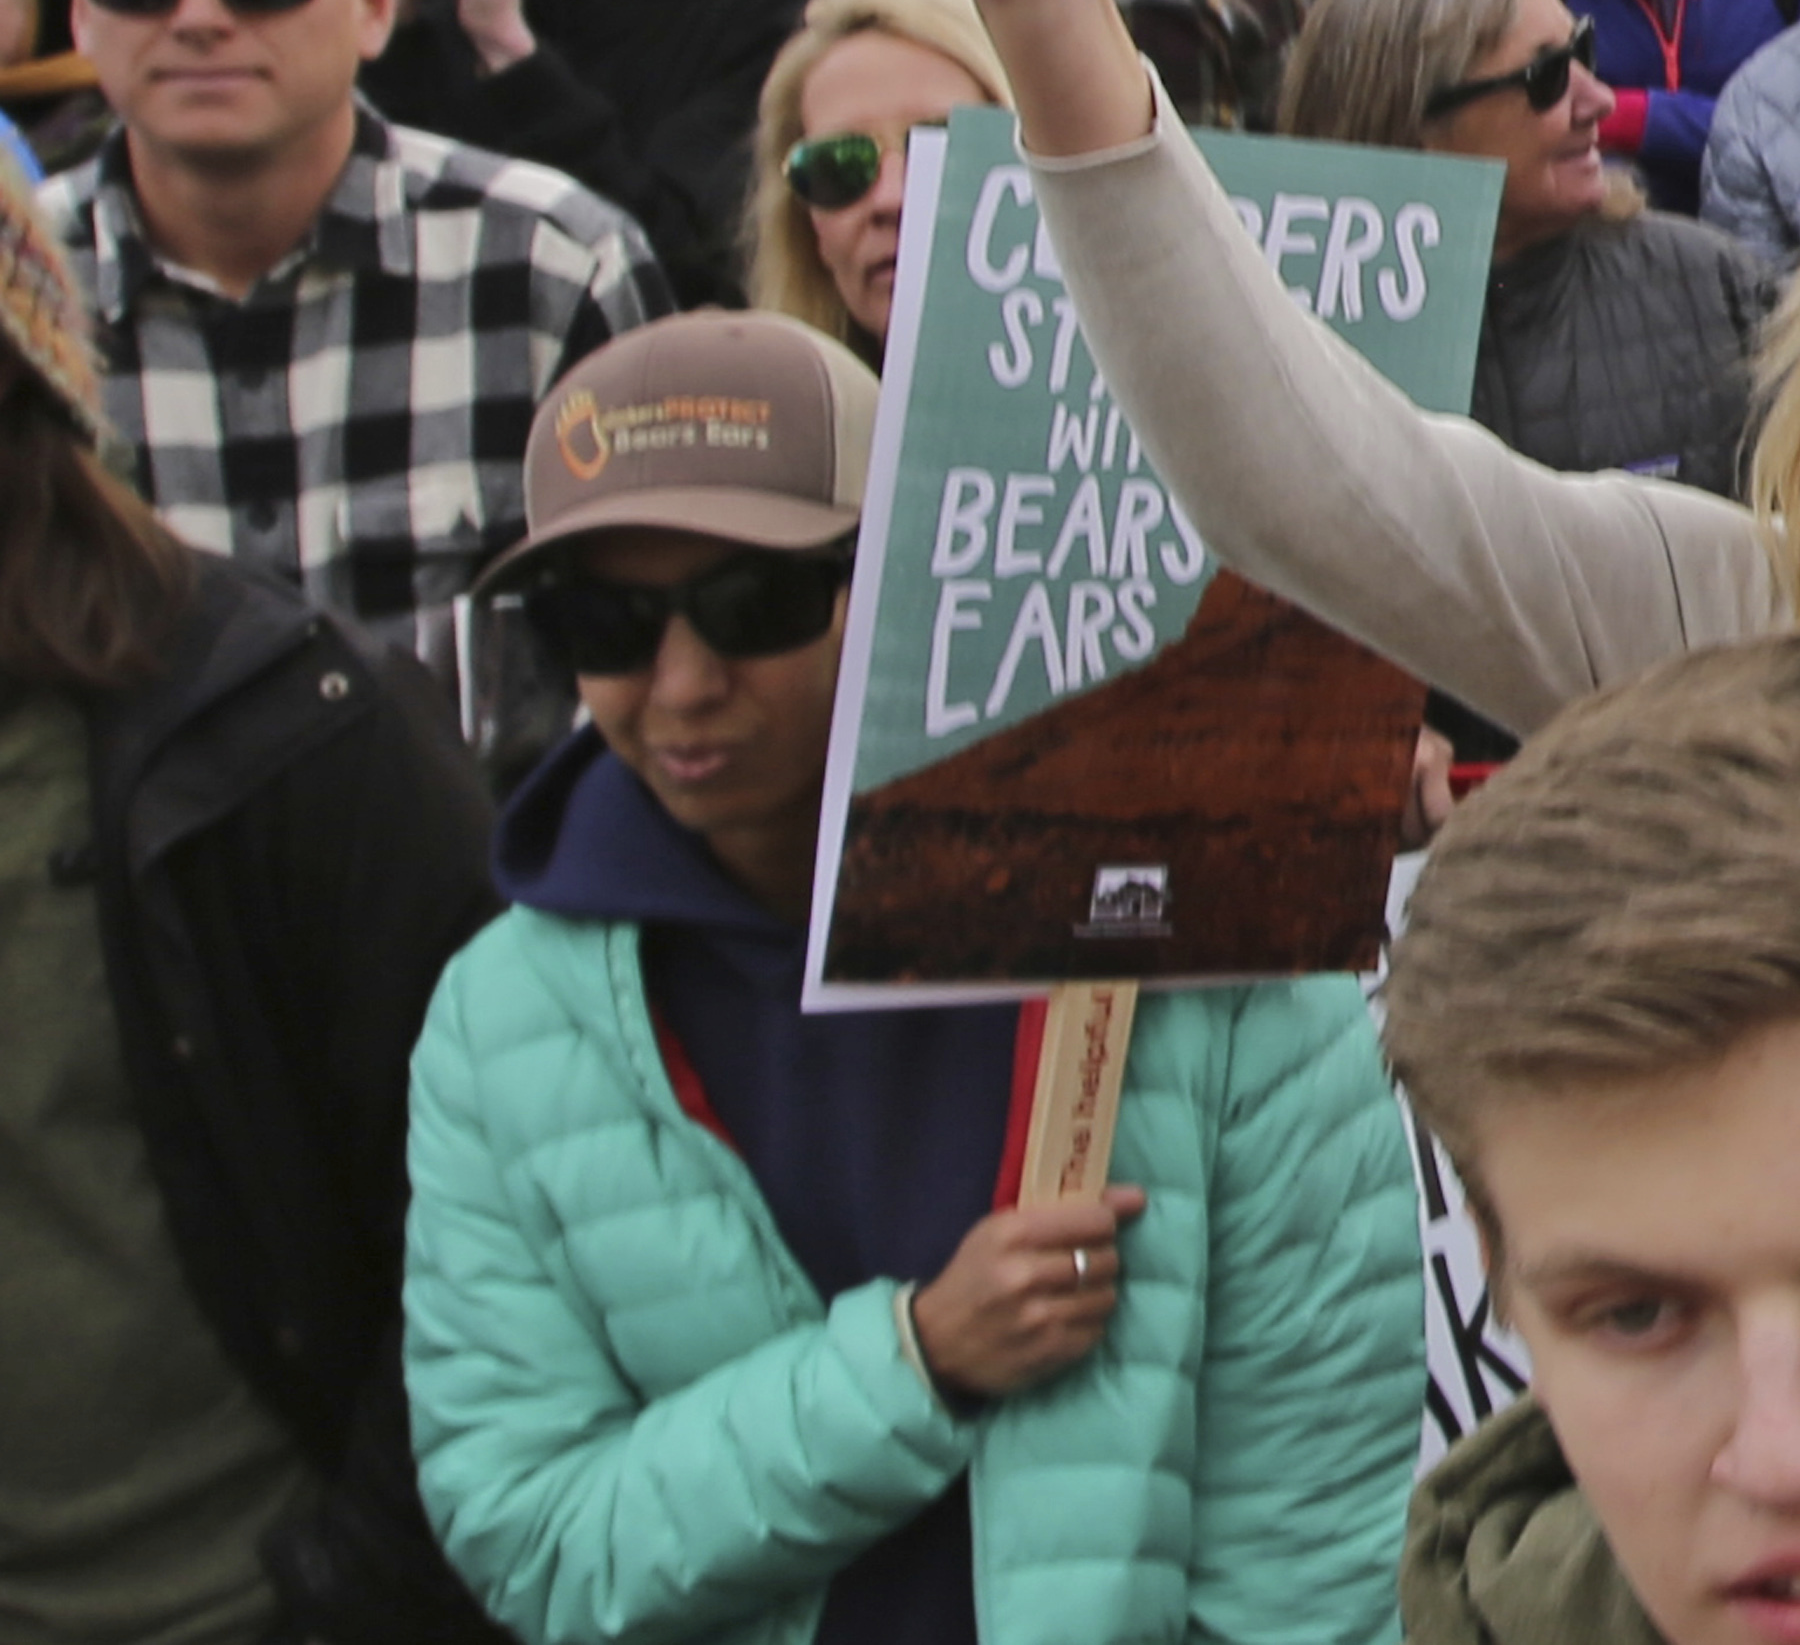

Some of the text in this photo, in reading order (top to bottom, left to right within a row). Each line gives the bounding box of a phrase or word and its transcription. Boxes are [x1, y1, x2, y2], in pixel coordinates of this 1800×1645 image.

[615, 418, 768, 454] Bears Ears
[931, 466, 1204, 585] BEARS
[925, 579, 1156, 738] EARS
